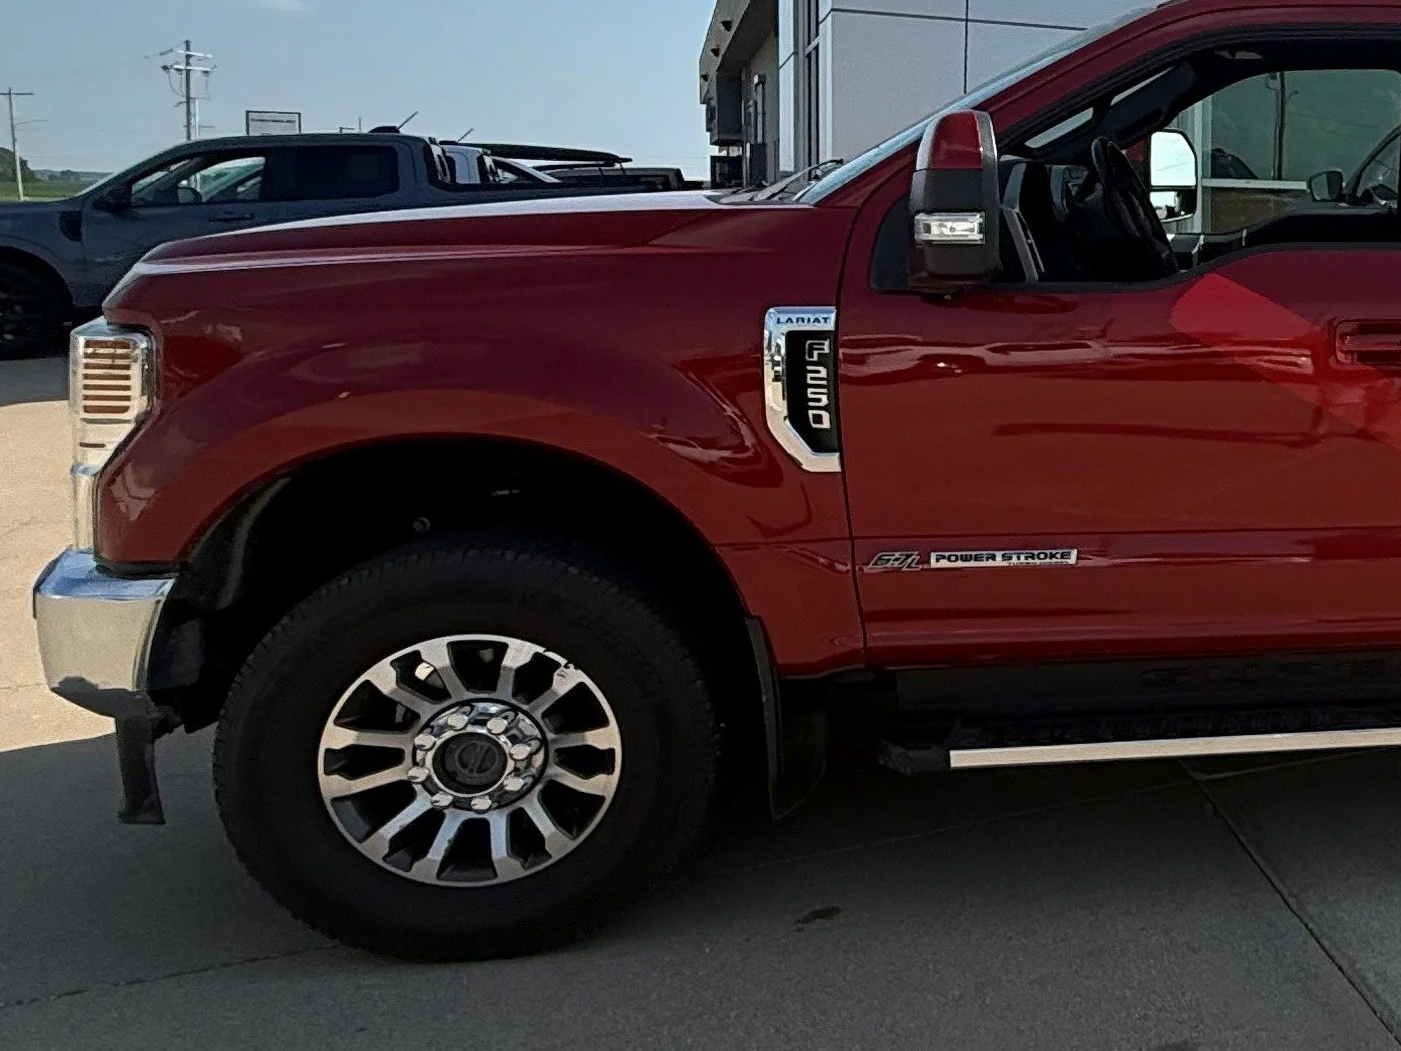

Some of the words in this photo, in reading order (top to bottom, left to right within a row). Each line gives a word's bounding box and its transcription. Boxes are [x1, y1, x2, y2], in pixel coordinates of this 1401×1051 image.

[776, 316, 831, 324] LARIAT
[805, 338, 831, 429] F250
[935, 552, 997, 563] POWER
[1001, 551, 1072, 562] STROKE
